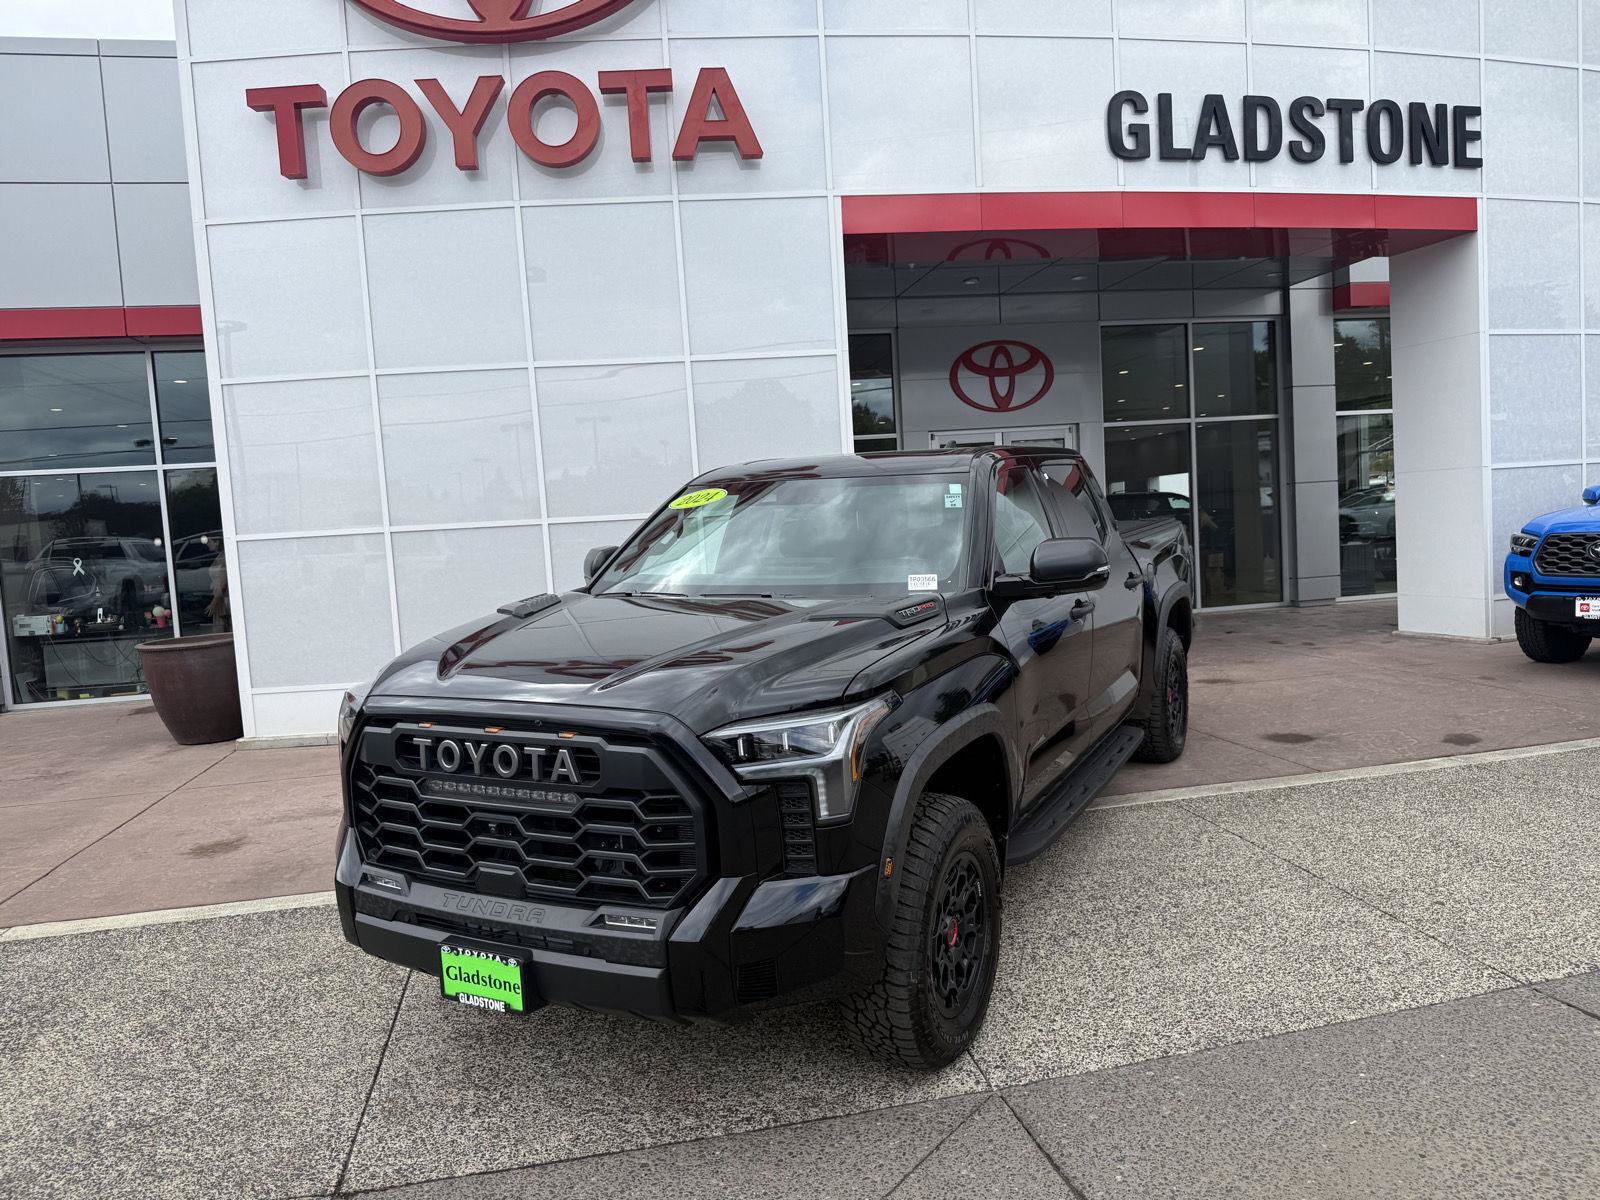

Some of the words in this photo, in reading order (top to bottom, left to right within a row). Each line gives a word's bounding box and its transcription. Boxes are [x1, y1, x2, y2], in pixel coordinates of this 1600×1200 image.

[246, 67, 763, 181] TOYOTA
[1107, 89, 1483, 169] GLADSTONE
[675, 491, 720, 507] 2024
[413, 738, 579, 784] TOYOTA
[443, 892, 546, 924] TUNDRA
[458, 948, 501, 963] TOYOTA
[445, 965, 521, 995] Gladstone
[458, 993, 506, 1013] GLADSTONE
